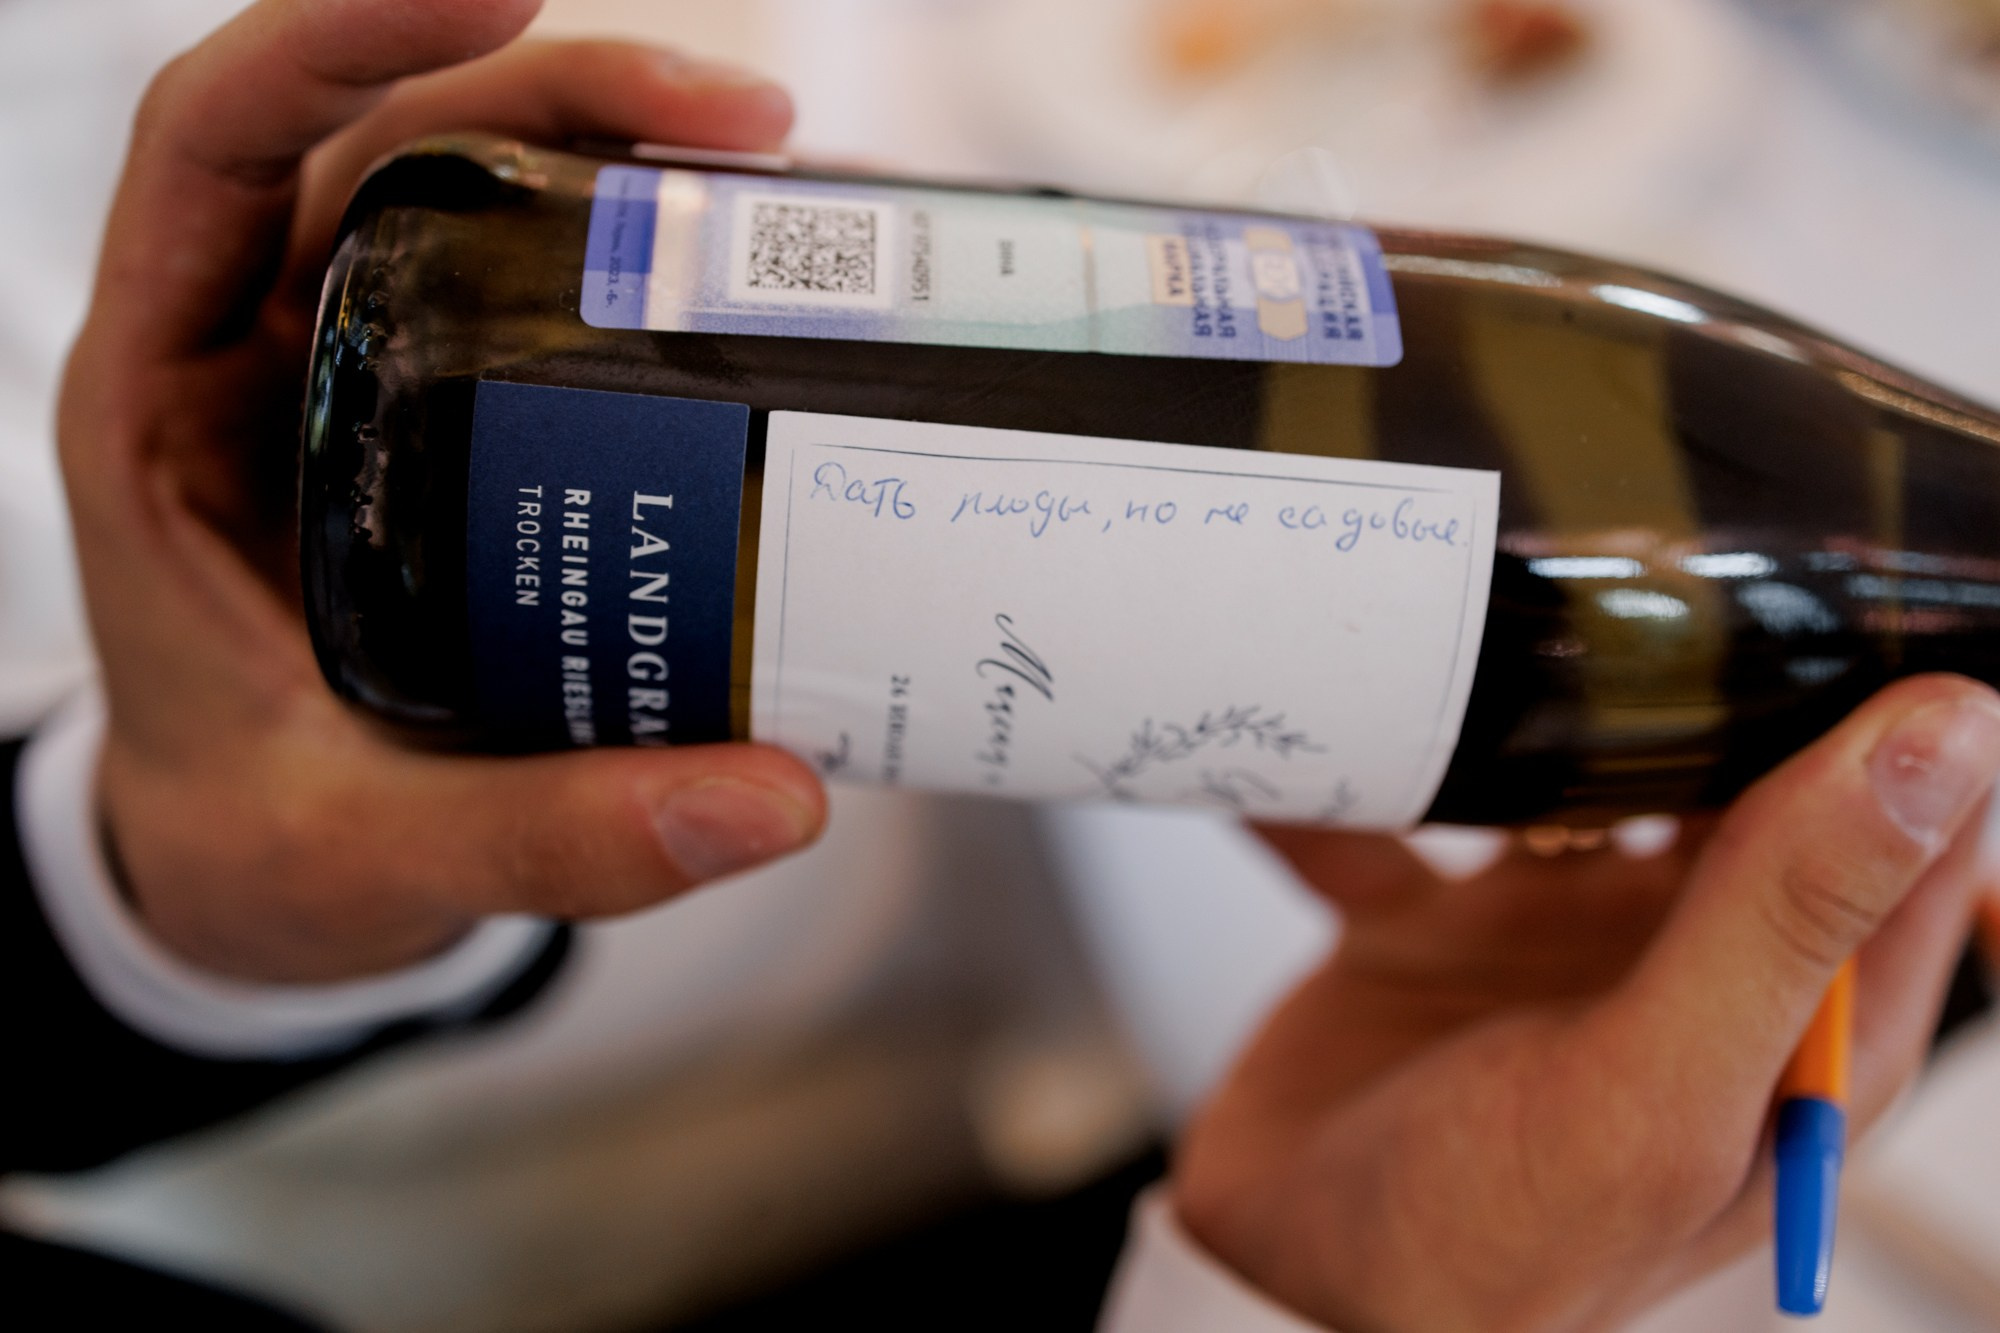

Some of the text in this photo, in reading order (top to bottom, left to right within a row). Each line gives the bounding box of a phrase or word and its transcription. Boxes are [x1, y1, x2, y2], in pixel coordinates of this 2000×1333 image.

[515, 485, 542, 606] TROCKEN
[561, 488, 591, 646] RHEINGAU
[1125, 501, 1177, 523] но
[627, 490, 673, 745] LANDGRA
